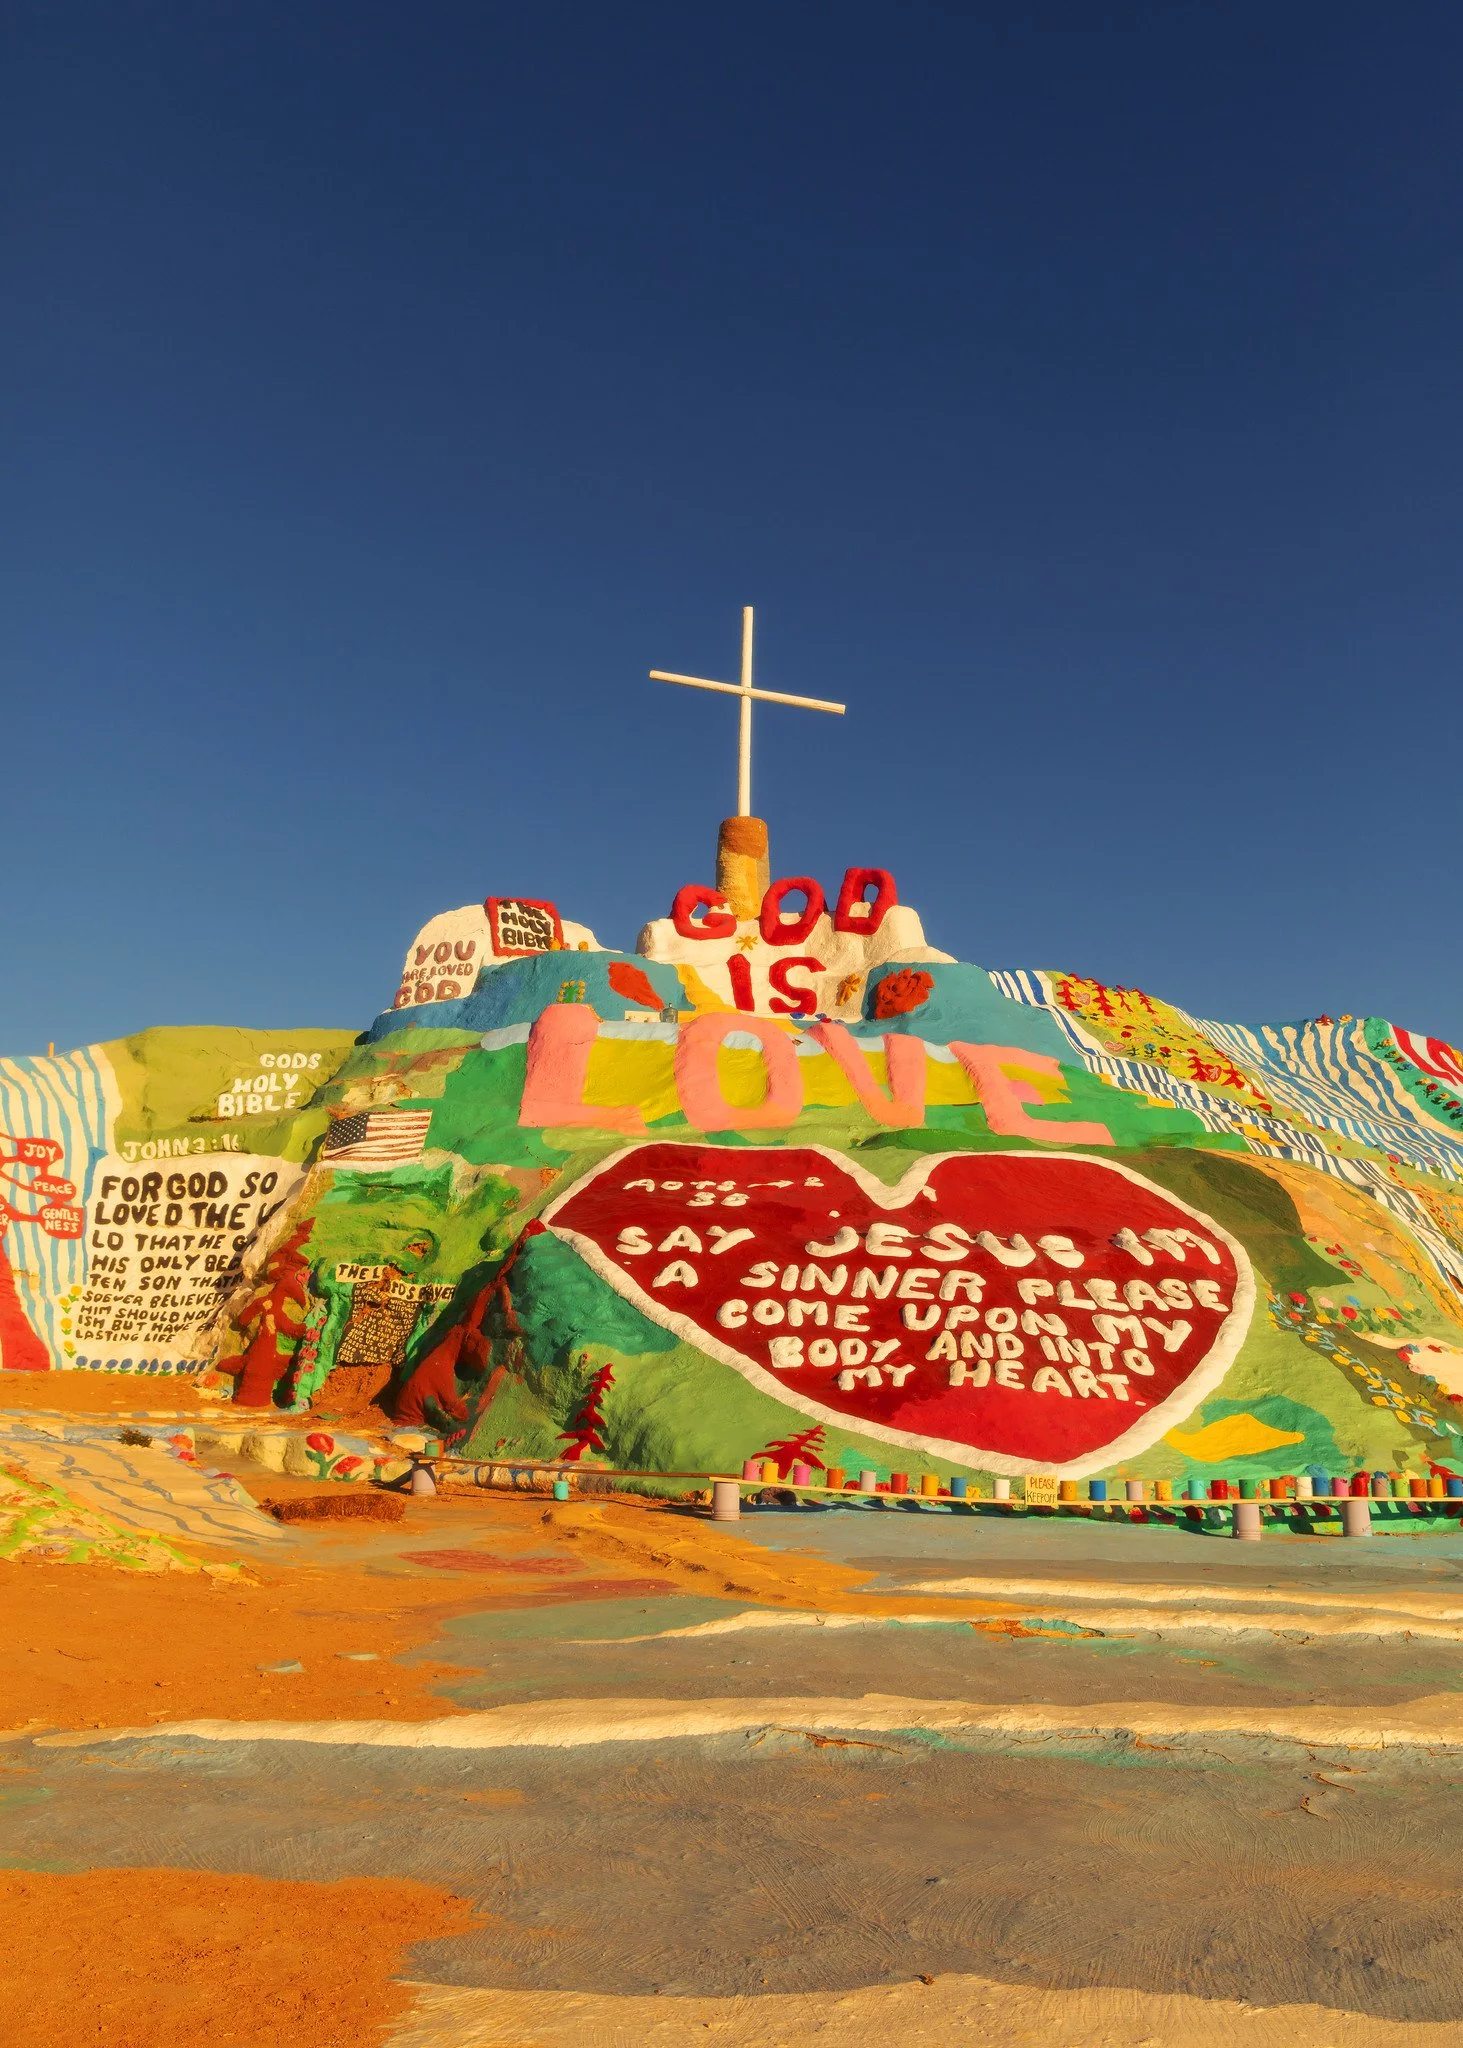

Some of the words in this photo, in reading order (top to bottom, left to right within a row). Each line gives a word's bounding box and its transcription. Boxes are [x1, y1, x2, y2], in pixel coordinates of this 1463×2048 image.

[500, 900, 546, 921] THE
[672, 867, 898, 946] GOD
[501, 912, 551, 936] HOLY
[414, 940, 476, 966] YOU
[402, 968, 427, 983] ARE
[430, 963, 473, 979] LOVED
[394, 980, 461, 1008] GOD
[727, 954, 826, 1015] IS
[260, 1053, 322, 1069] GODS
[231, 1072, 299, 1094] HOLY
[517, 1003, 1116, 1146] LOVE
[218, 1092, 301, 1117] BIBLE
[24, 1143, 56, 1161] JOY
[121, 1136, 189, 1162] JOHN
[33, 1181, 73, 1195] PEACE
[101, 1172, 163, 1203] FOR
[166, 1171, 228, 1200] GOD
[239, 1172, 278, 1198] SO
[42, 1208, 80, 1222] GENTLE
[94, 1201, 183, 1226] LOVED
[188, 1202, 251, 1230] THE
[45, 1220, 78, 1233] NESS
[135, 1233, 196, 1251] THAT
[197, 1234, 226, 1250] HE
[615, 1225, 755, 1255] SAY
[804, 1222, 1085, 1269] JESUS
[92, 1254, 130, 1274] HIS
[140, 1254, 201, 1274] ONLY
[339, 1264, 369, 1280] THE
[89, 1274, 127, 1292] TEN
[139, 1275, 182, 1291] SON
[652, 1259, 699, 1288] A
[740, 1260, 987, 1304] SINNER
[1016, 1278, 1230, 1312] PLEASE
[82, 1290, 144, 1306] SOEVER
[80, 1305, 112, 1315] HIM
[115, 1308, 180, 1323] SHOULD
[111, 1319, 148, 1332] BUT
[151, 1322, 193, 1333] HAVE
[716, 1298, 870, 1332] COME
[902, 1303, 1068, 1336] UPON
[1092, 1314, 1193, 1352] MY
[75, 1329, 139, 1342] LASTING
[144, 1334, 176, 1343] LIFE
[768, 1335, 901, 1368] BODY
[925, 1331, 1024, 1360] AND
[1039, 1336, 1155, 1376] INTO
[837, 1364, 916, 1391] MY
[1030, 1477, 1055, 1489] PLEASE
